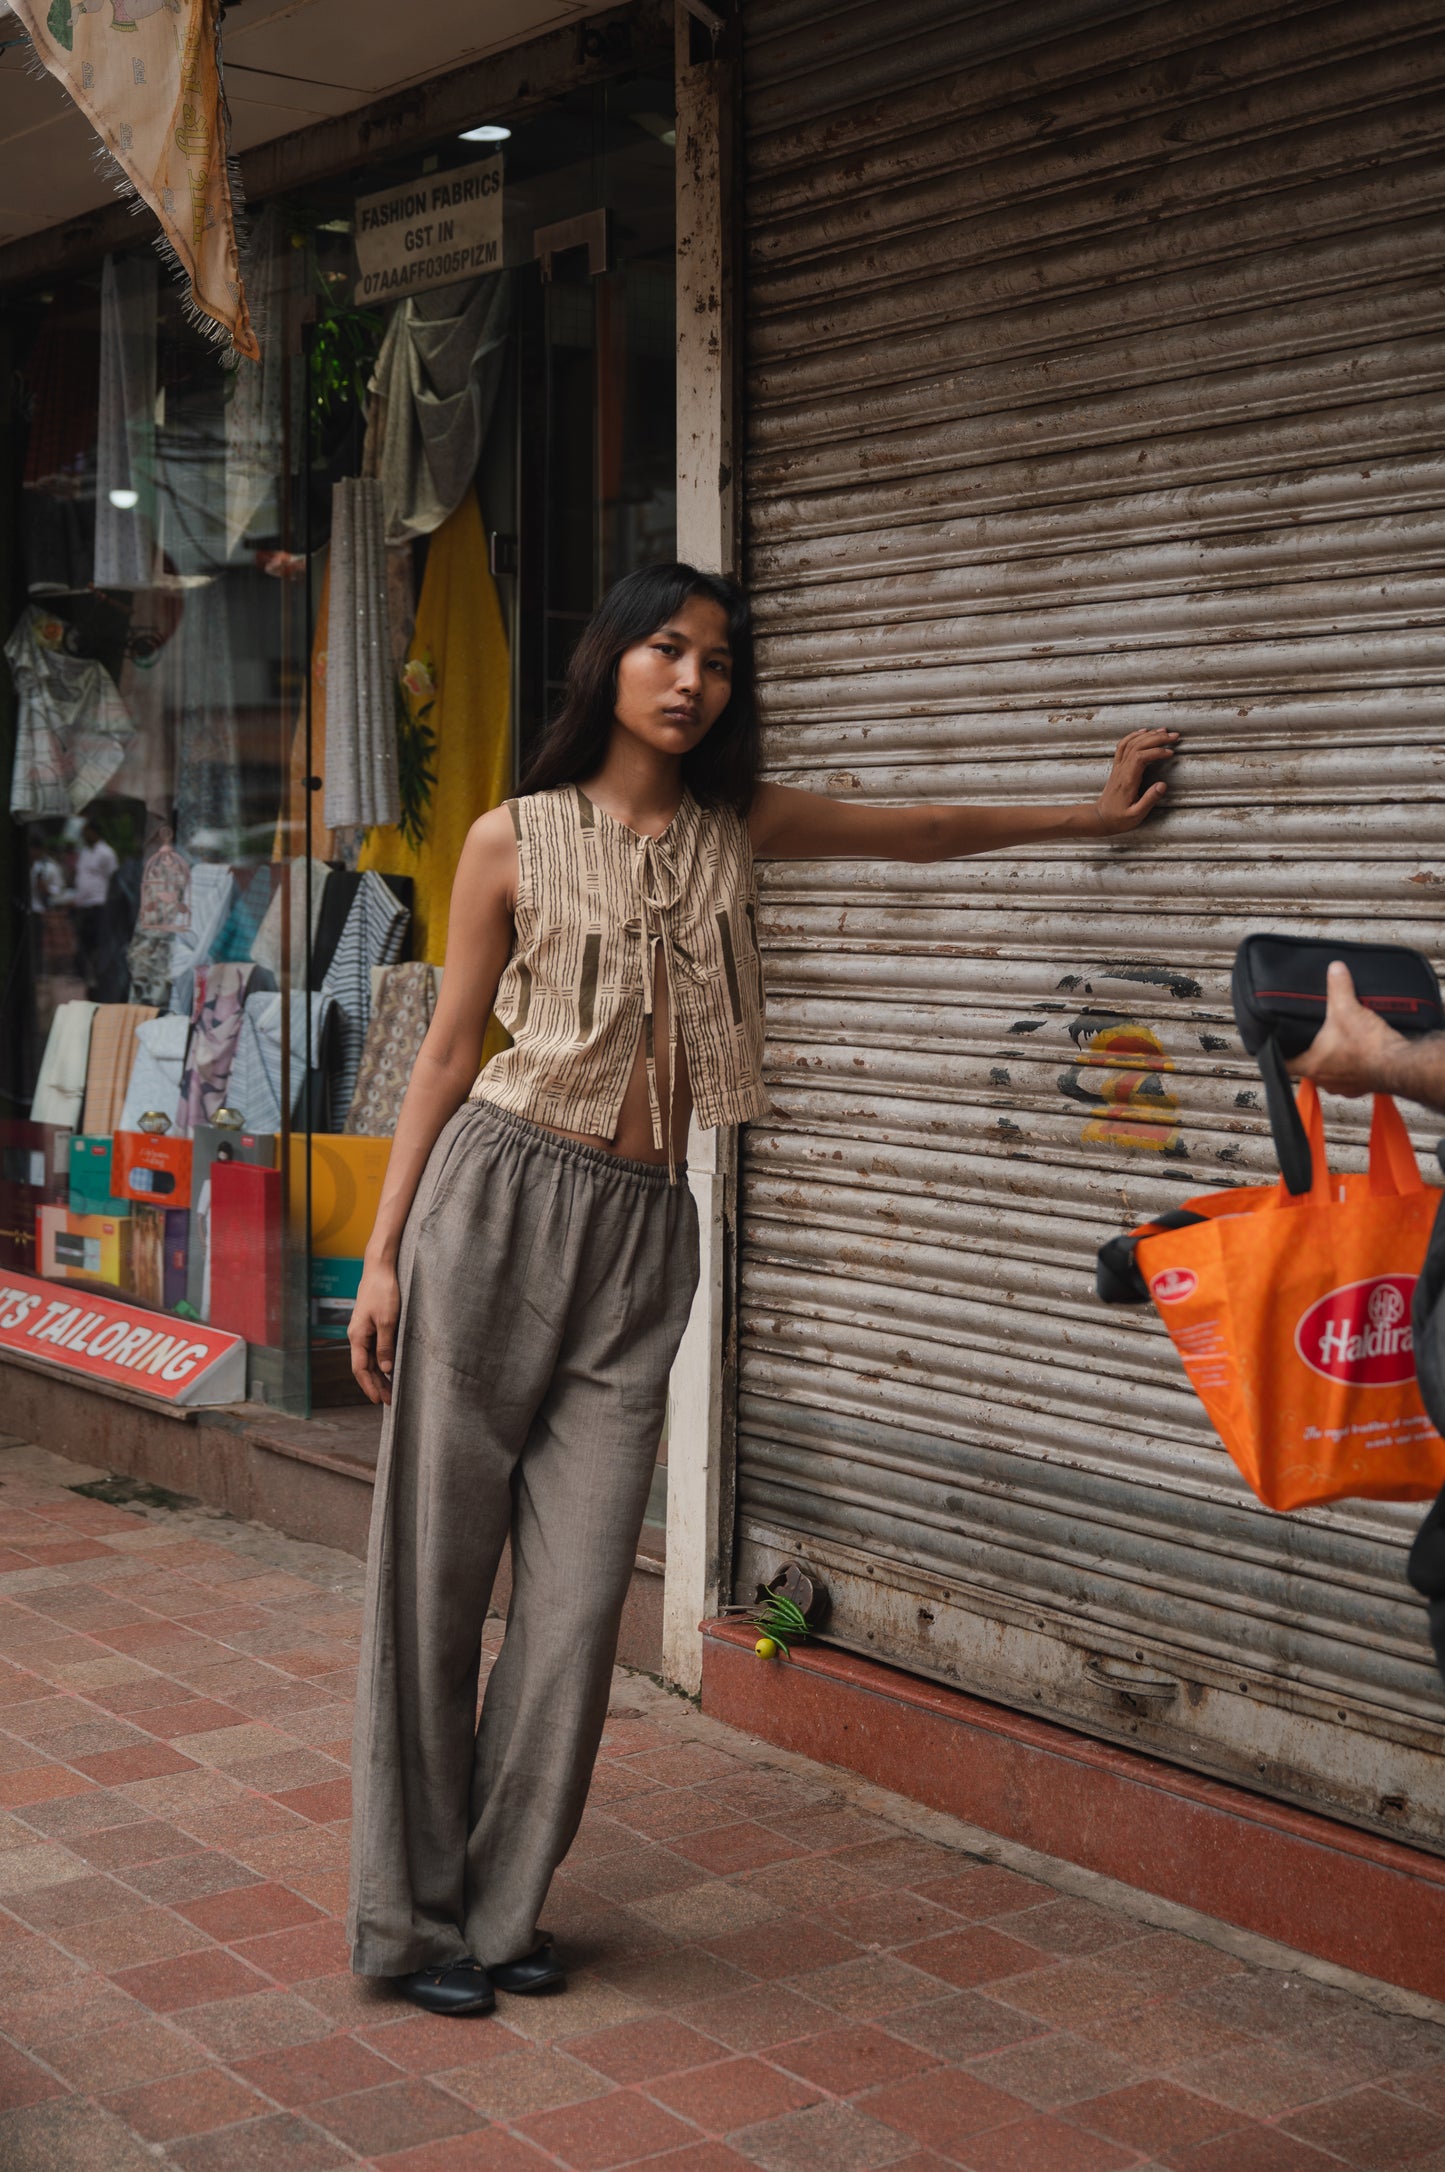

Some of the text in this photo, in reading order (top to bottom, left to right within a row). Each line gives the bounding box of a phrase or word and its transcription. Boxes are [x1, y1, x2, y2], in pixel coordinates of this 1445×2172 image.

[362, 170, 500, 231] FASHION FABRICS
[404, 219, 454, 251] GST IN
[26, 1301, 209, 1381] TAILORING
[1318, 1319, 1414, 1365] Haldira
